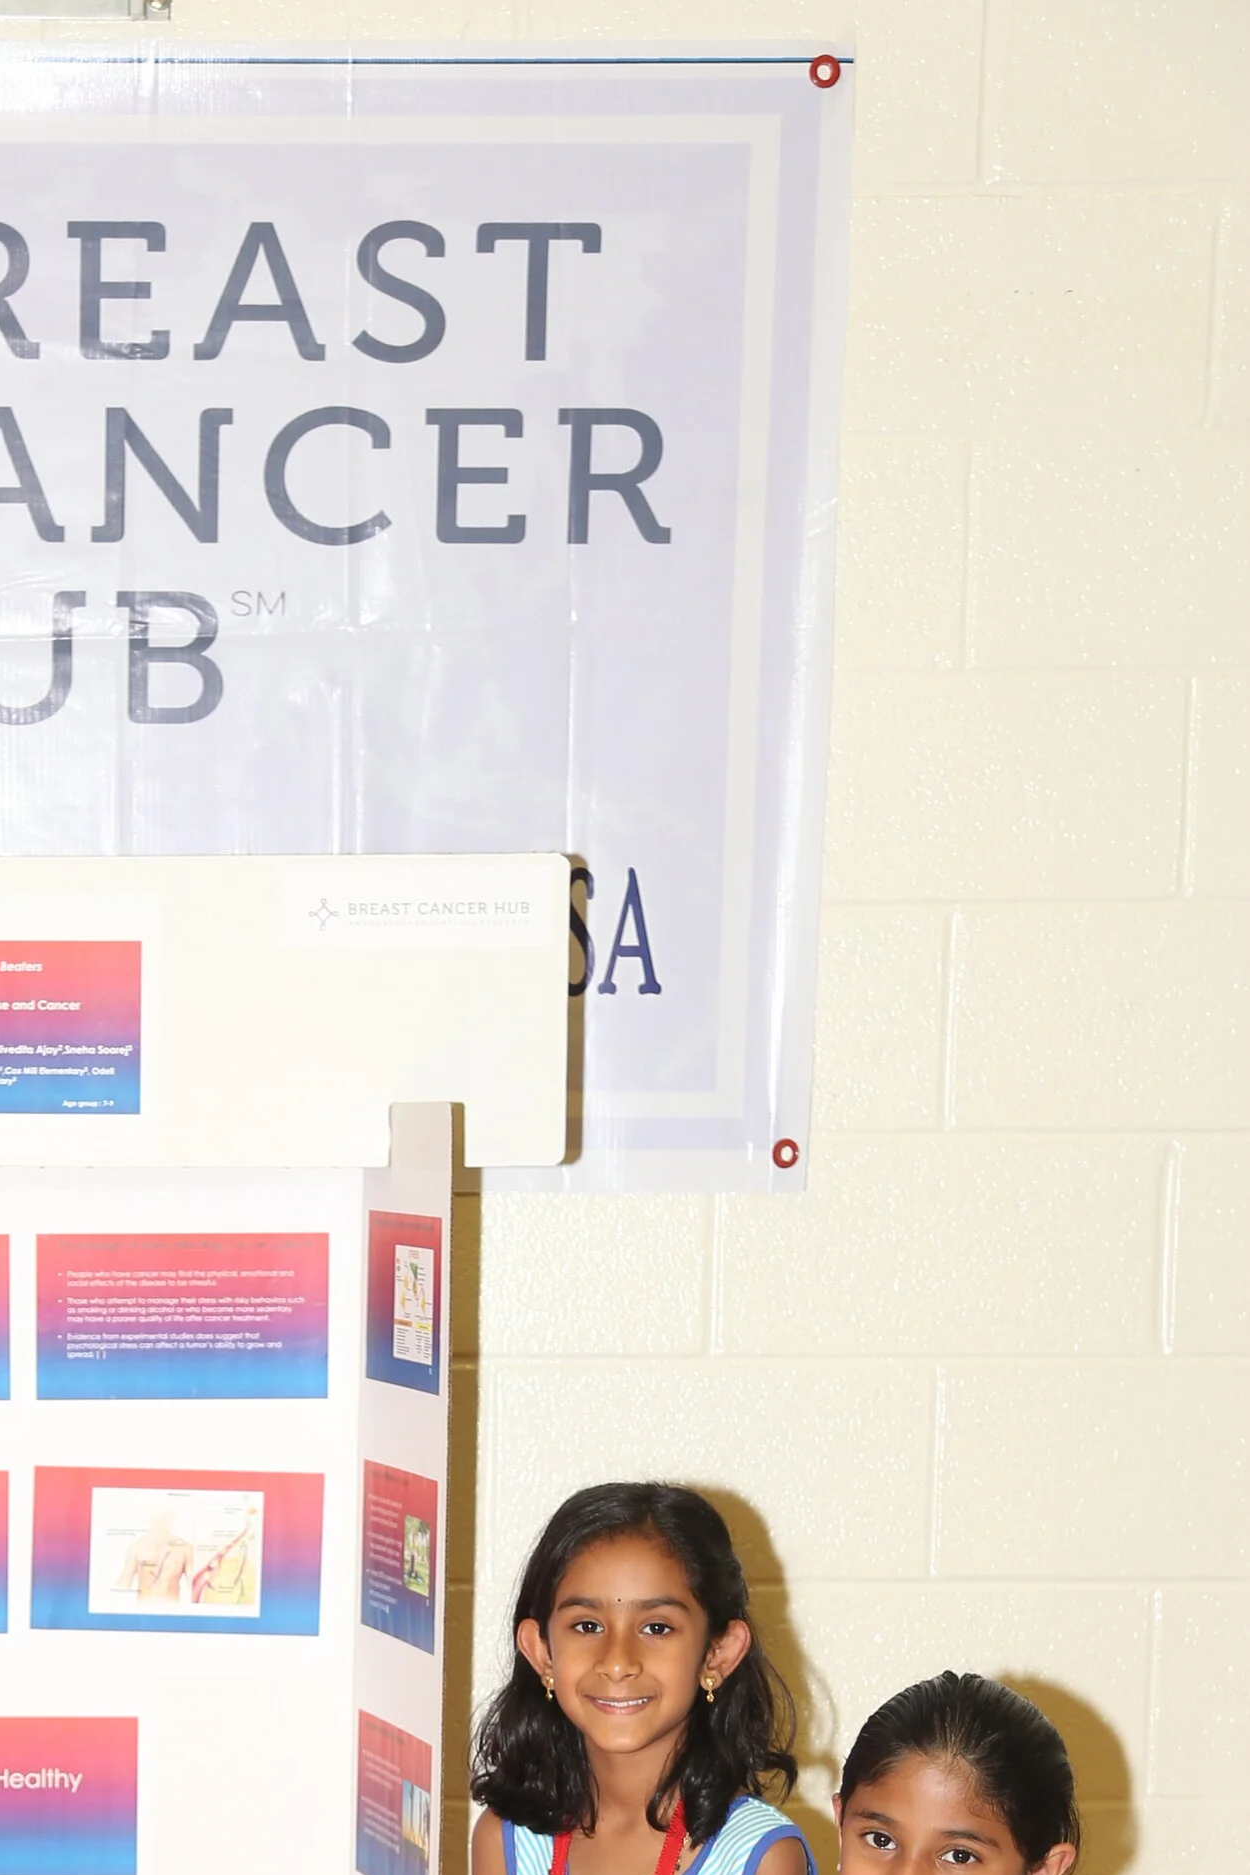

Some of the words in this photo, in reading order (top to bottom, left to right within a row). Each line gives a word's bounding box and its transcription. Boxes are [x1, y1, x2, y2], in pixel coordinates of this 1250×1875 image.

[348, 902, 411, 915] BREAST
[417, 902, 488, 916] CANCER
[494, 901, 530, 915] HUB
[0, 961, 43, 972] Beaters
[12, 1000, 36, 1011] and
[37, 1000, 81, 1011] Cancer
[120, 1333, 168, 1342] experimental
[195, 1332, 214, 1340] does
[67, 1341, 118, 1350] psychological
